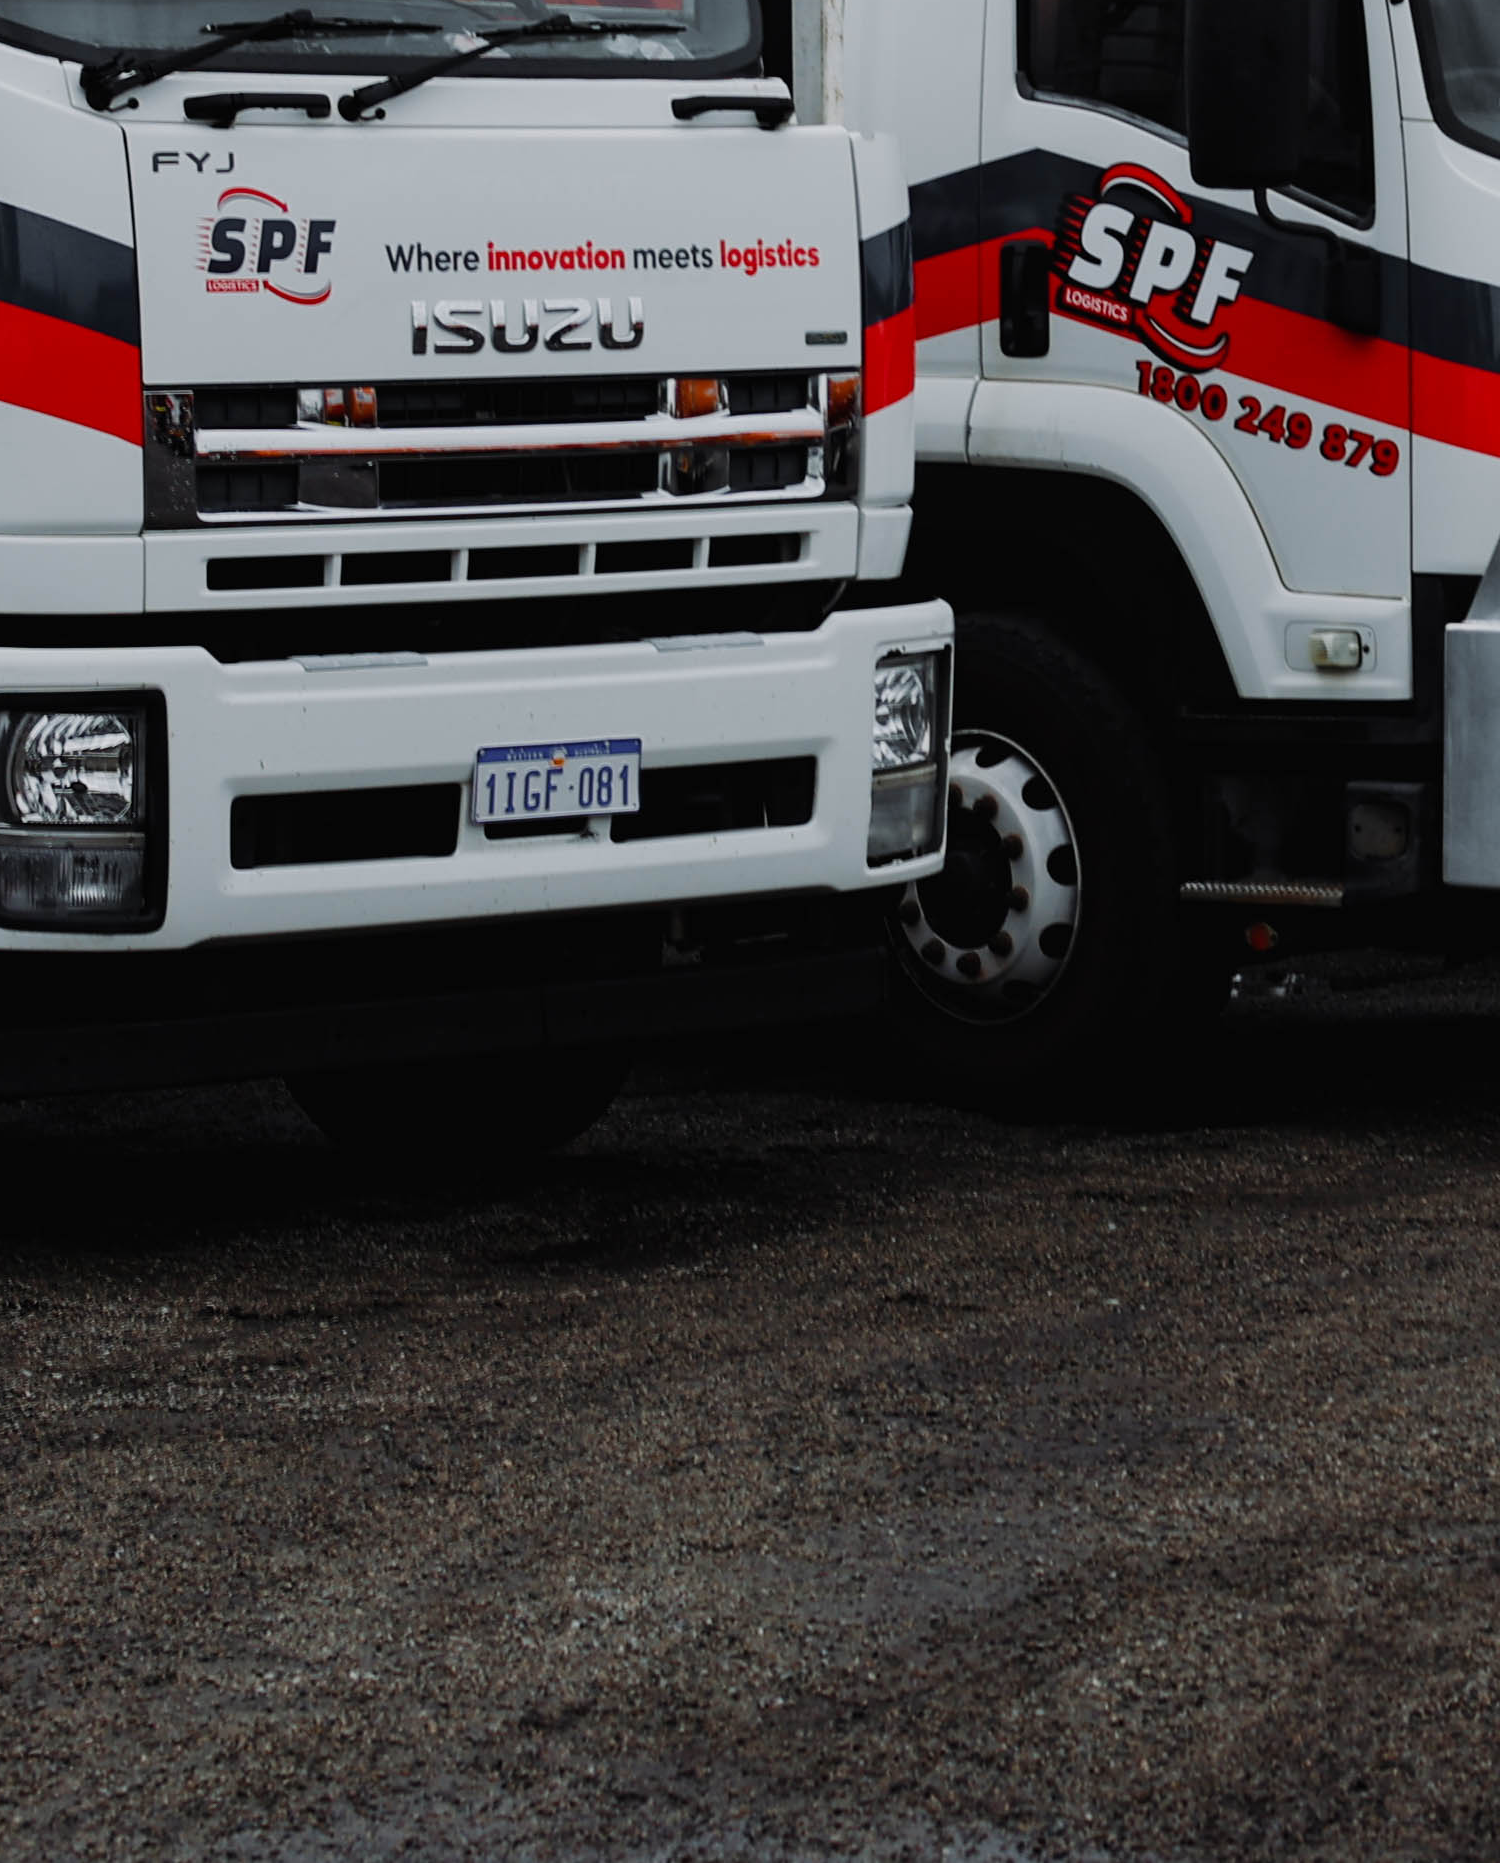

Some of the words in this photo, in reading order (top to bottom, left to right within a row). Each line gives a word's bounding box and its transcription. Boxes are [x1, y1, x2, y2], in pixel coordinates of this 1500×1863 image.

[152, 151, 235, 174] FYJ
[207, 217, 337, 274] SPF
[385, 243, 480, 273] Where
[487, 241, 626, 271] innovation
[633, 244, 714, 269] meets
[720, 239, 820, 276] logistics
[1067, 202, 1254, 325] SPF
[410, 296, 645, 356] ISUZU
[1064, 289, 1129, 322] LOGISTICS
[1136, 360, 1228, 421] 1800
[1234, 395, 1313, 449] 249
[1319, 424, 1400, 477] 879
